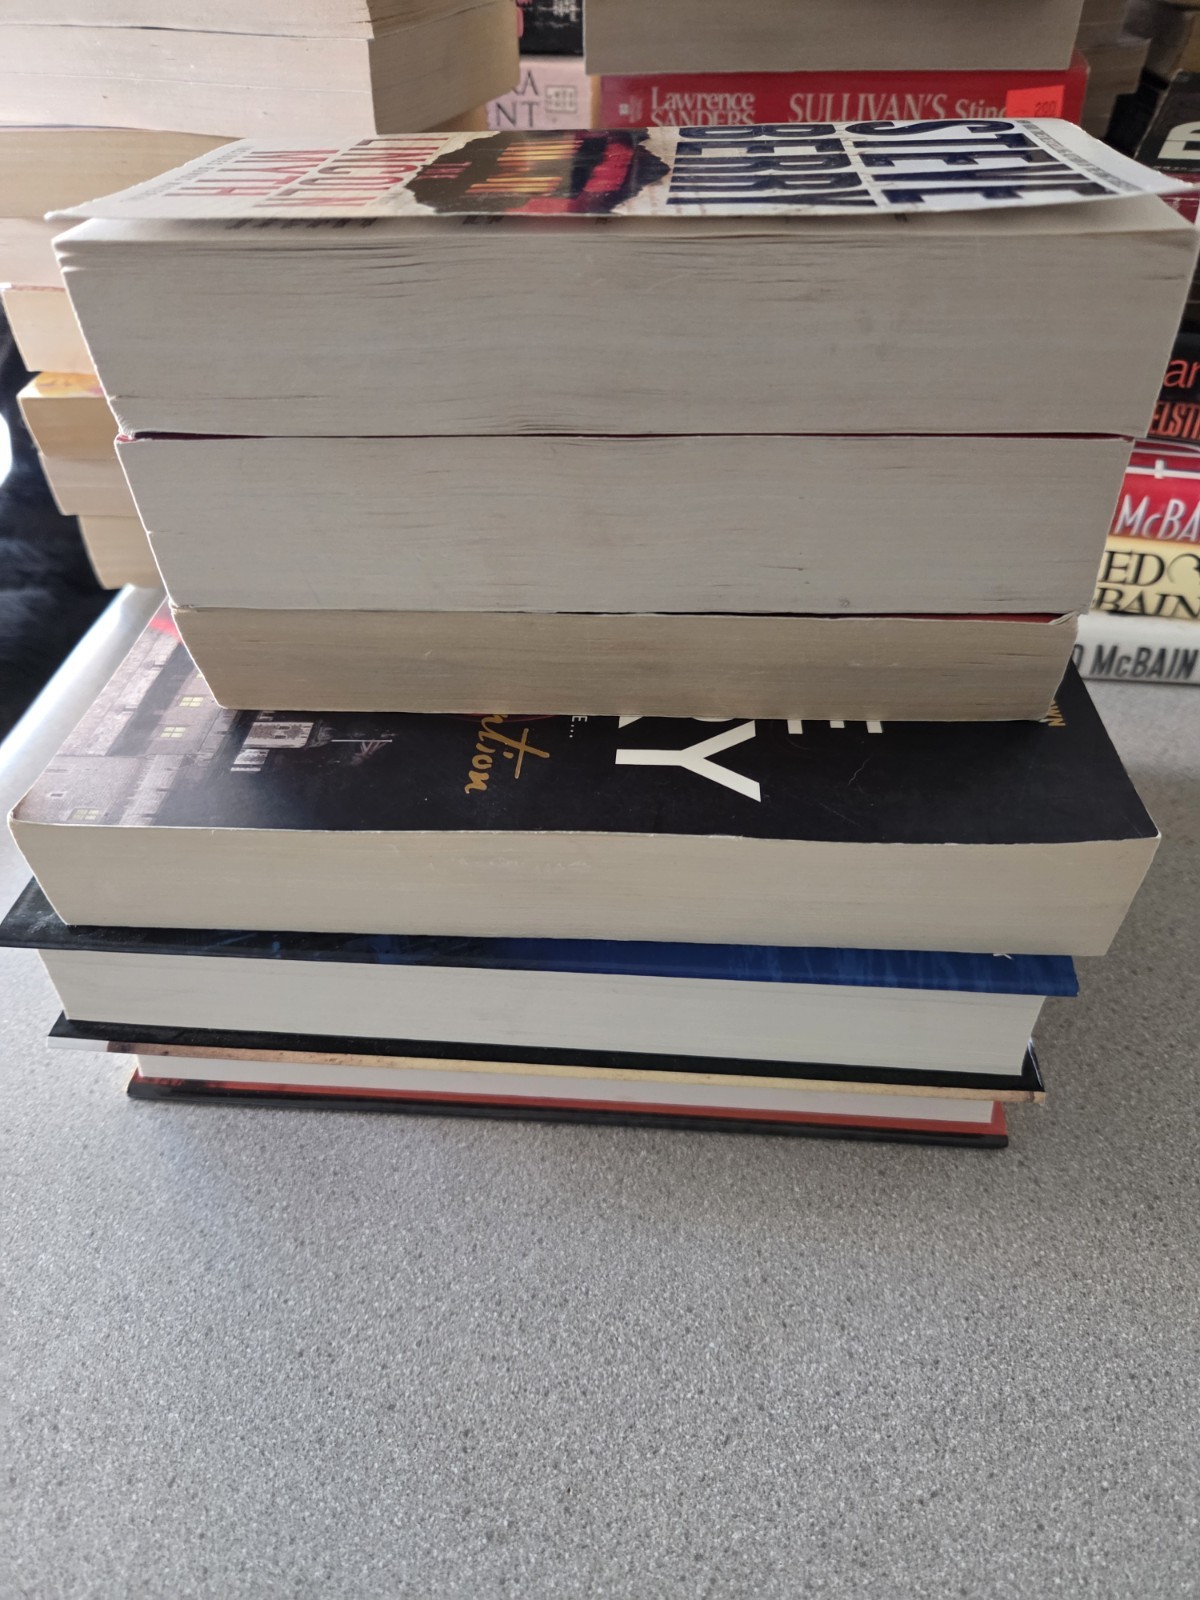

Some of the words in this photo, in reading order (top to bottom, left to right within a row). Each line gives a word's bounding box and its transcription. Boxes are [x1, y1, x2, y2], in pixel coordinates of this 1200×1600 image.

[650, 109, 756, 127] SANDERS
[651, 86, 756, 110] Lawrence
[788, 92, 948, 122] SULLIVAN'S
[161, 149, 340, 198] MYTH
[251, 137, 450, 208] LINCOLN
[666, 123, 879, 207] BERRY
[845, 118, 1121, 207] STEVE
[1089, 644, 1200, 681] McBAIN
